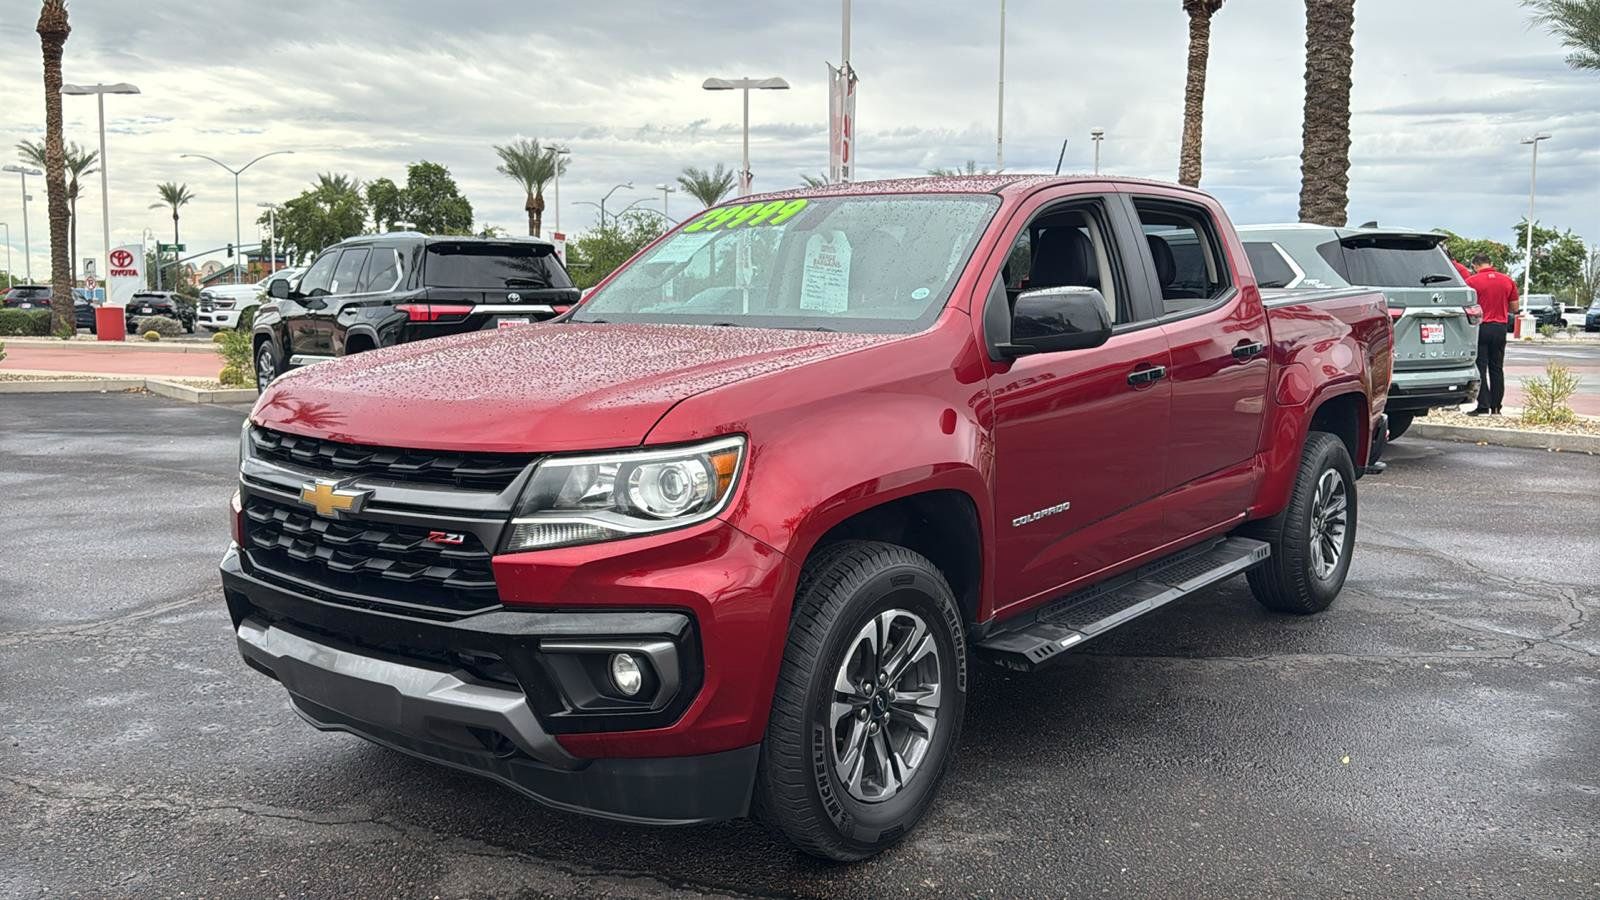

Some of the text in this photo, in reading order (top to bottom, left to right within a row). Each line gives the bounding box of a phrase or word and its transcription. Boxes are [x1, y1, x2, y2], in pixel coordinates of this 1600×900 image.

[683, 199, 807, 232] 29999
[110, 269, 138, 277] TOYOTA
[1012, 501, 1070, 527] COLORADO
[943, 606, 967, 689] MICHELIN
[813, 728, 842, 818] MICHELIN
